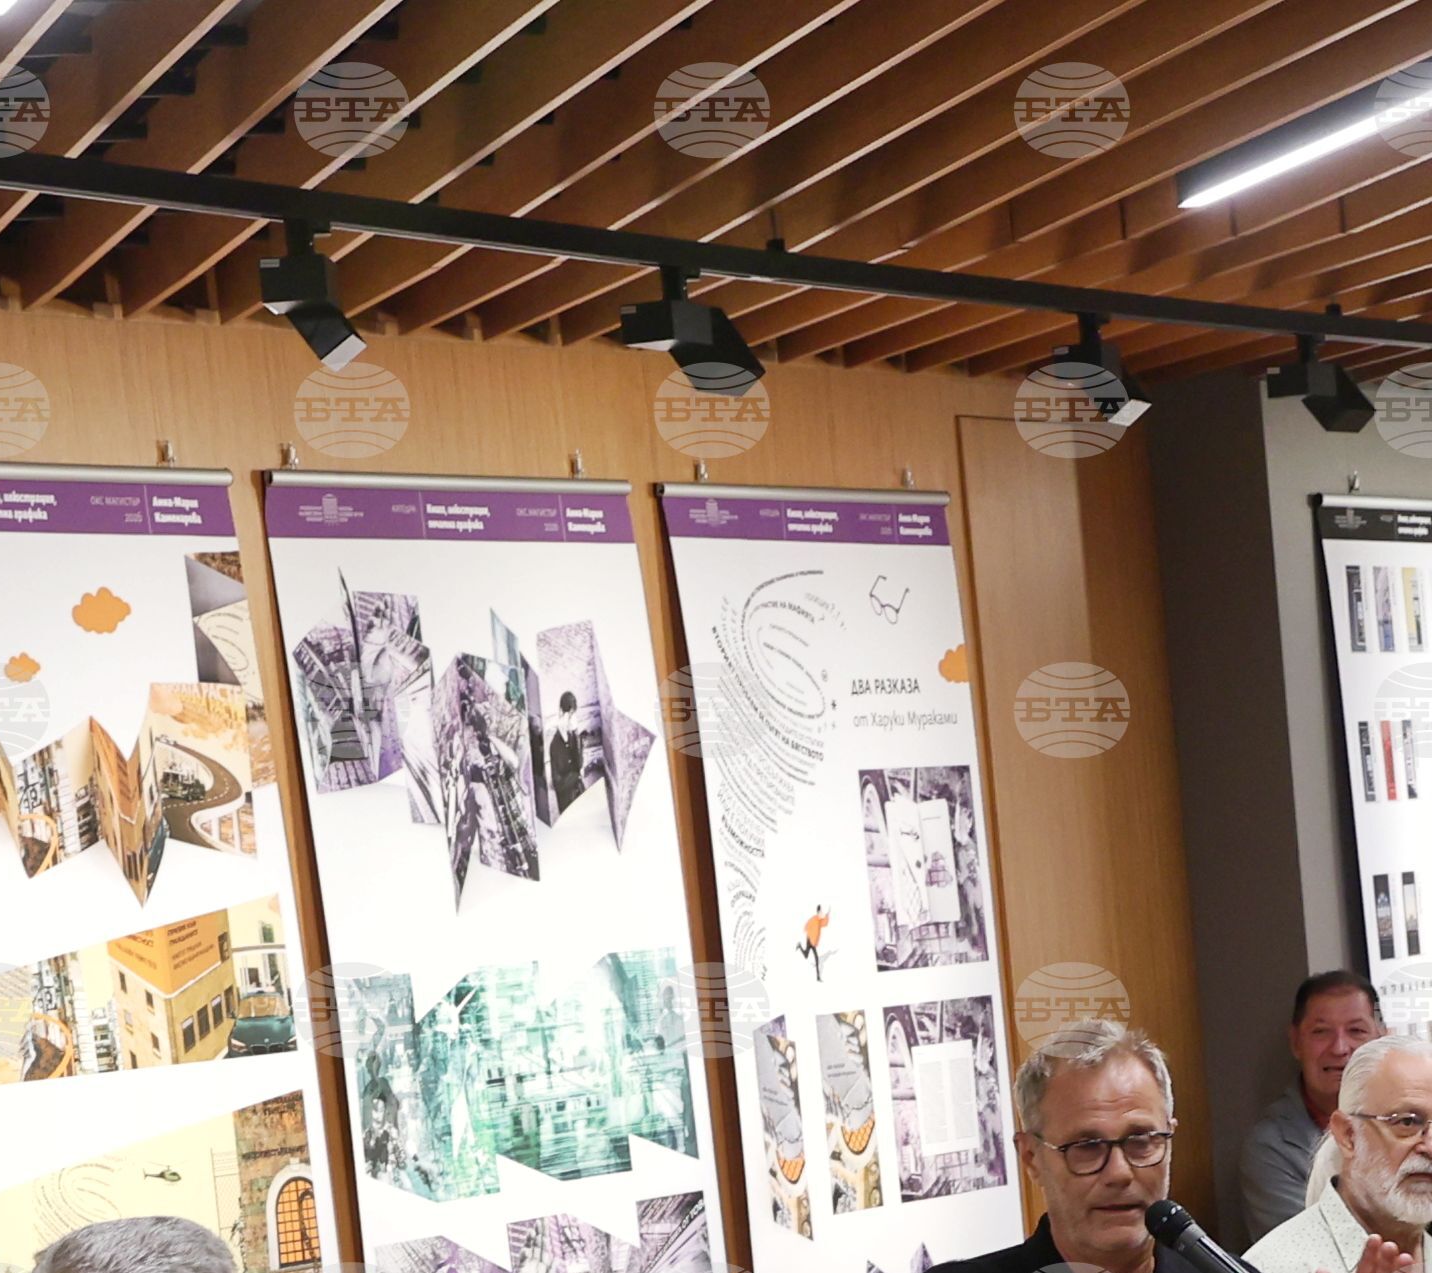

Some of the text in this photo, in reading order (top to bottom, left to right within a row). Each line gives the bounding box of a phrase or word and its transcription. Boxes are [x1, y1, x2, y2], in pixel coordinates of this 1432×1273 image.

[851, 678, 920, 696] ДВА РАЗКАЗА
[853, 708, 958, 731] от Харуки Мураками
